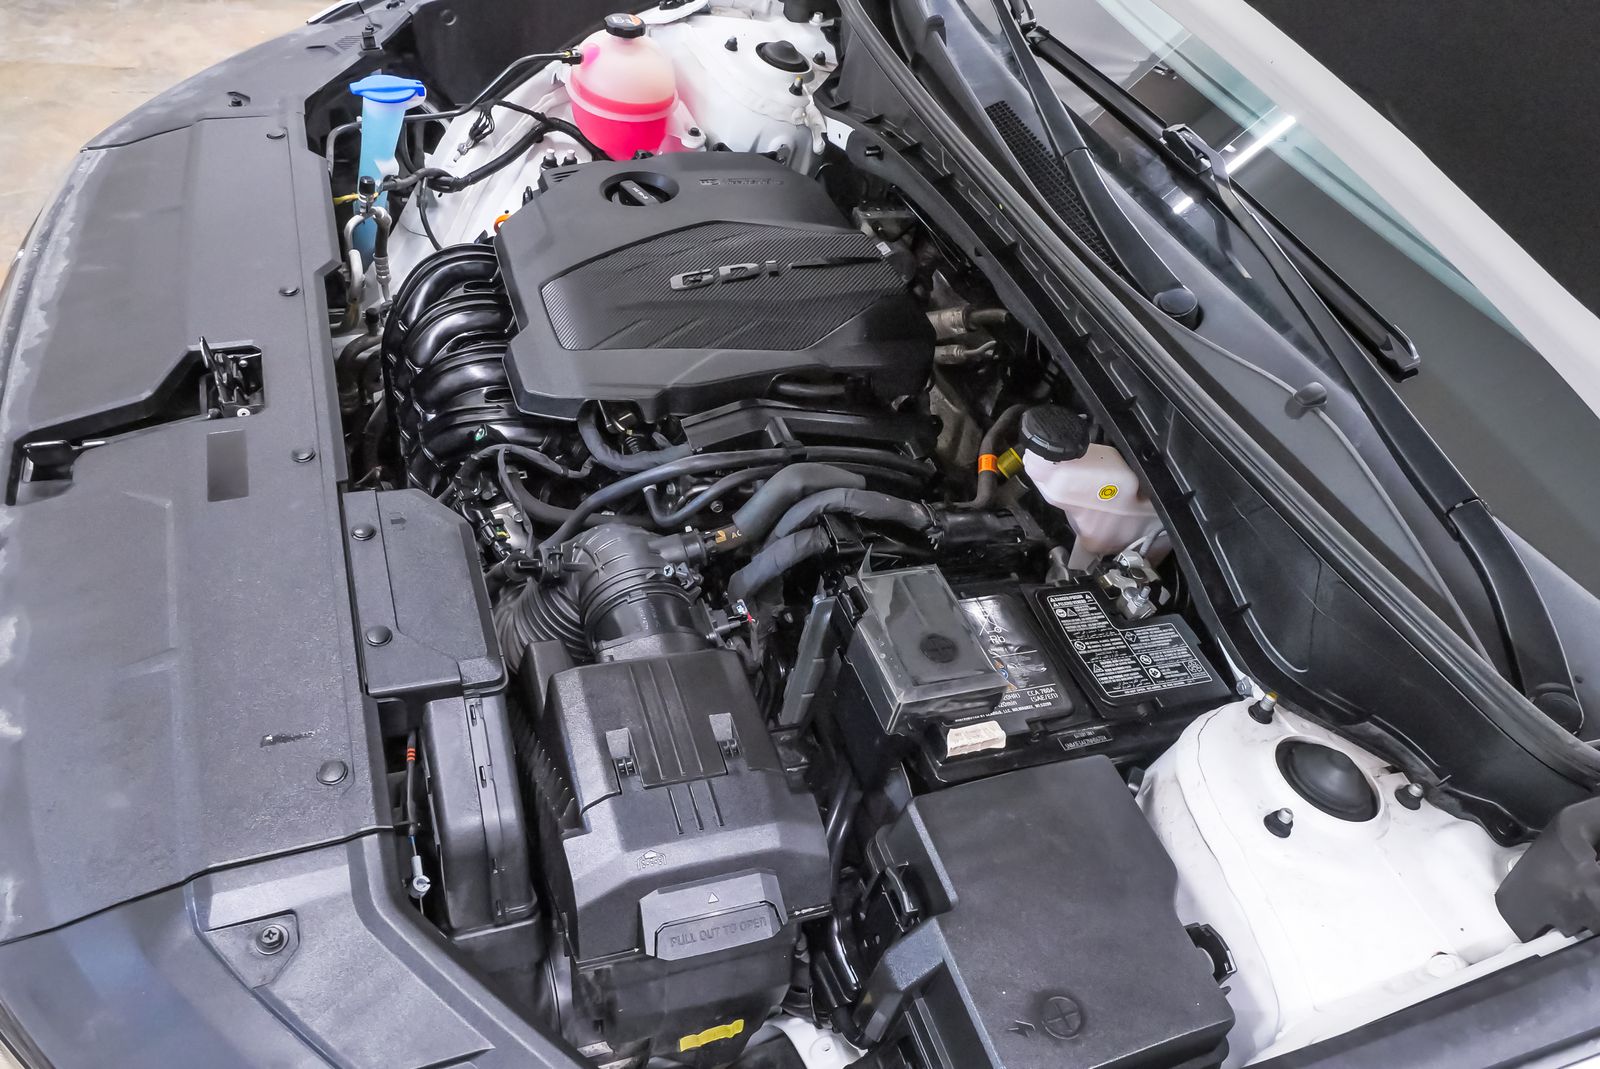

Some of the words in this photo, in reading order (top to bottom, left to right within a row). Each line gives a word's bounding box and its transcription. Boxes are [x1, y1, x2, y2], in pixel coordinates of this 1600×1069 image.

[670, 933, 697, 948] PULL
[699, 926, 720, 941] OUT
[722, 922, 737, 935] TO
[739, 916, 767, 931] OPEN
